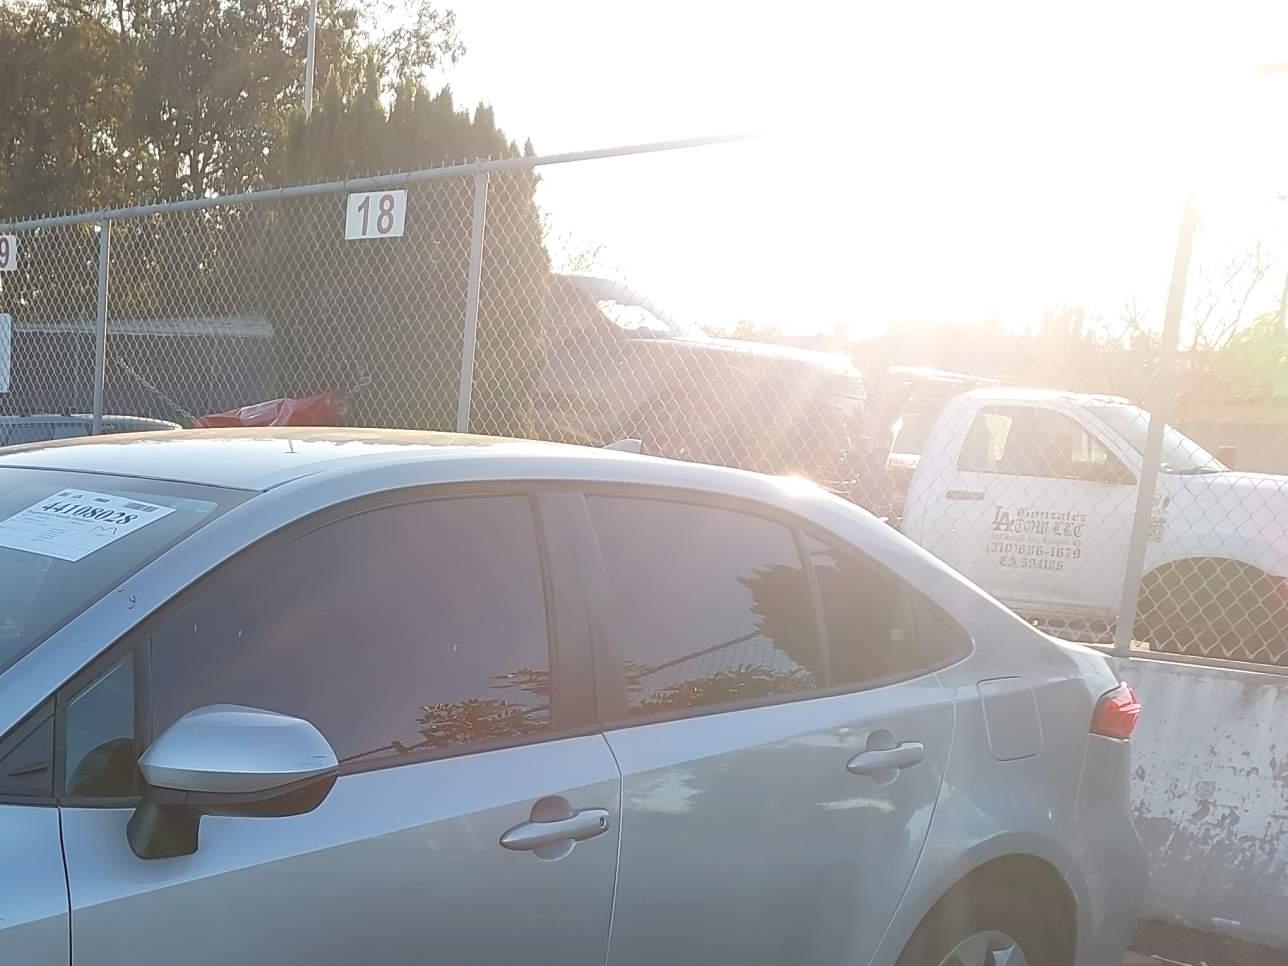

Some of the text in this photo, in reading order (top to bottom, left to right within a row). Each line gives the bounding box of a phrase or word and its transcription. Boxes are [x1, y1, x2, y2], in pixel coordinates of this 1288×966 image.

[357, 193, 395, 236] 18
[41, 501, 138, 525] 44108028
[991, 506, 1014, 532] LA
